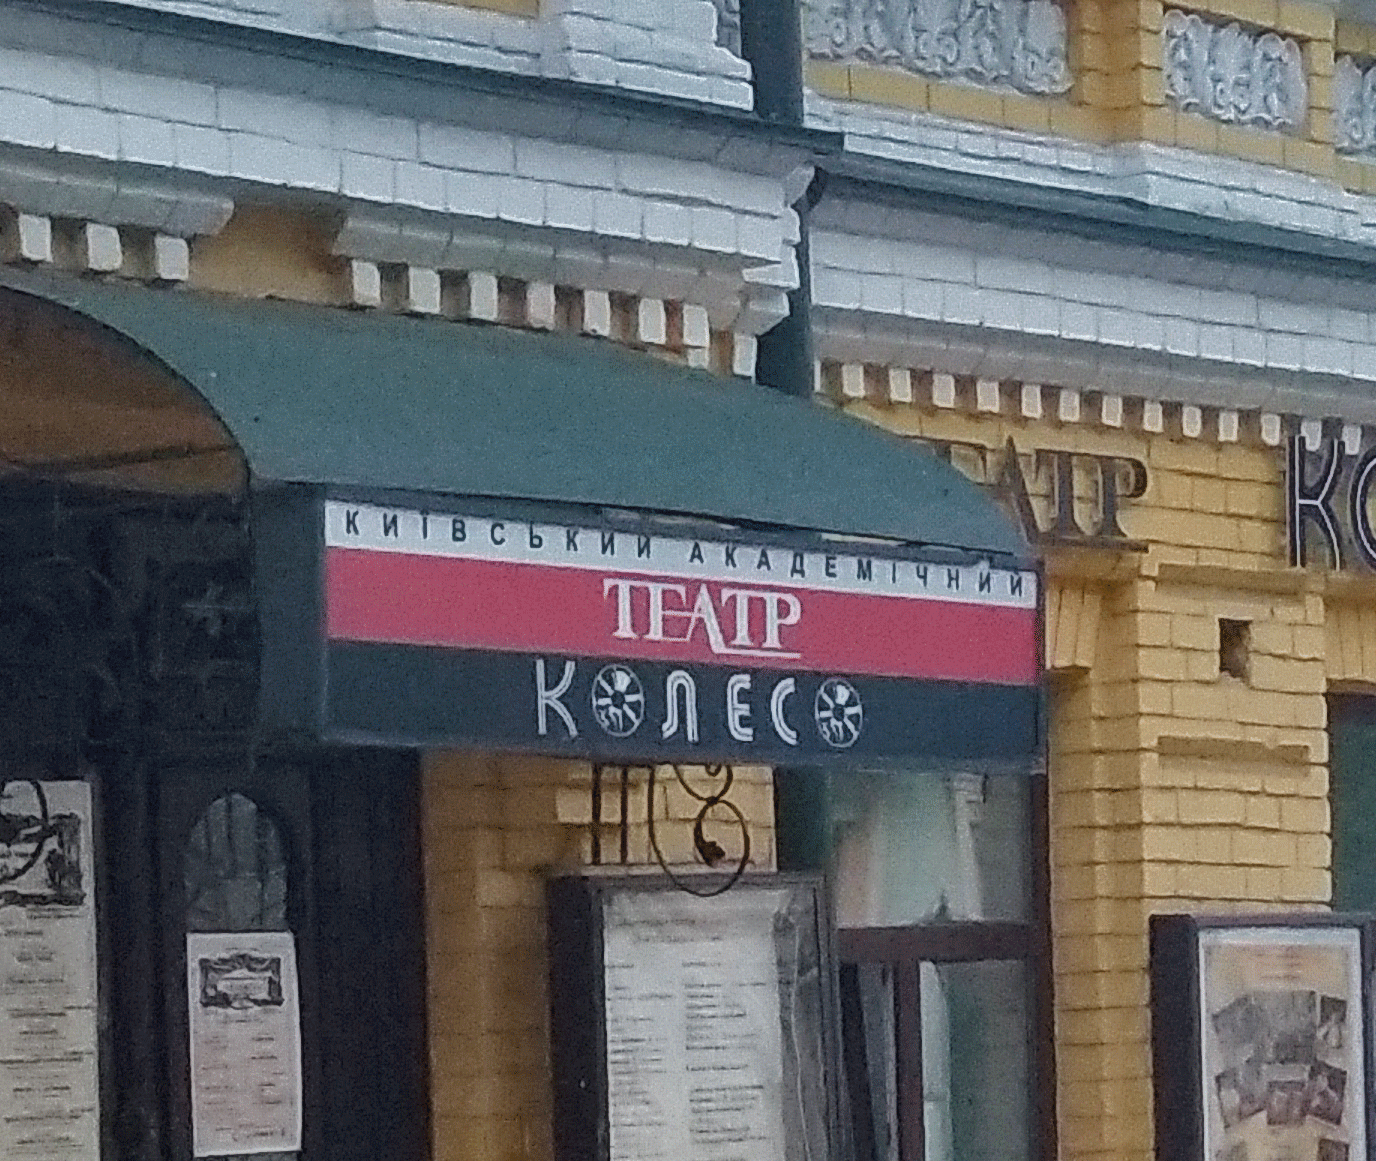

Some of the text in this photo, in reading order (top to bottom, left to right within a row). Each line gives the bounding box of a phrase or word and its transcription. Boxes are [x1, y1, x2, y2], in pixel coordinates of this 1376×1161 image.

[344, 507, 1024, 597] КИЇВСЬКИЙ АКАДЕМІЧНИЙ
[603, 578, 802, 659] ТЕАТР
[535, 659, 865, 749] КОЛЕСО
